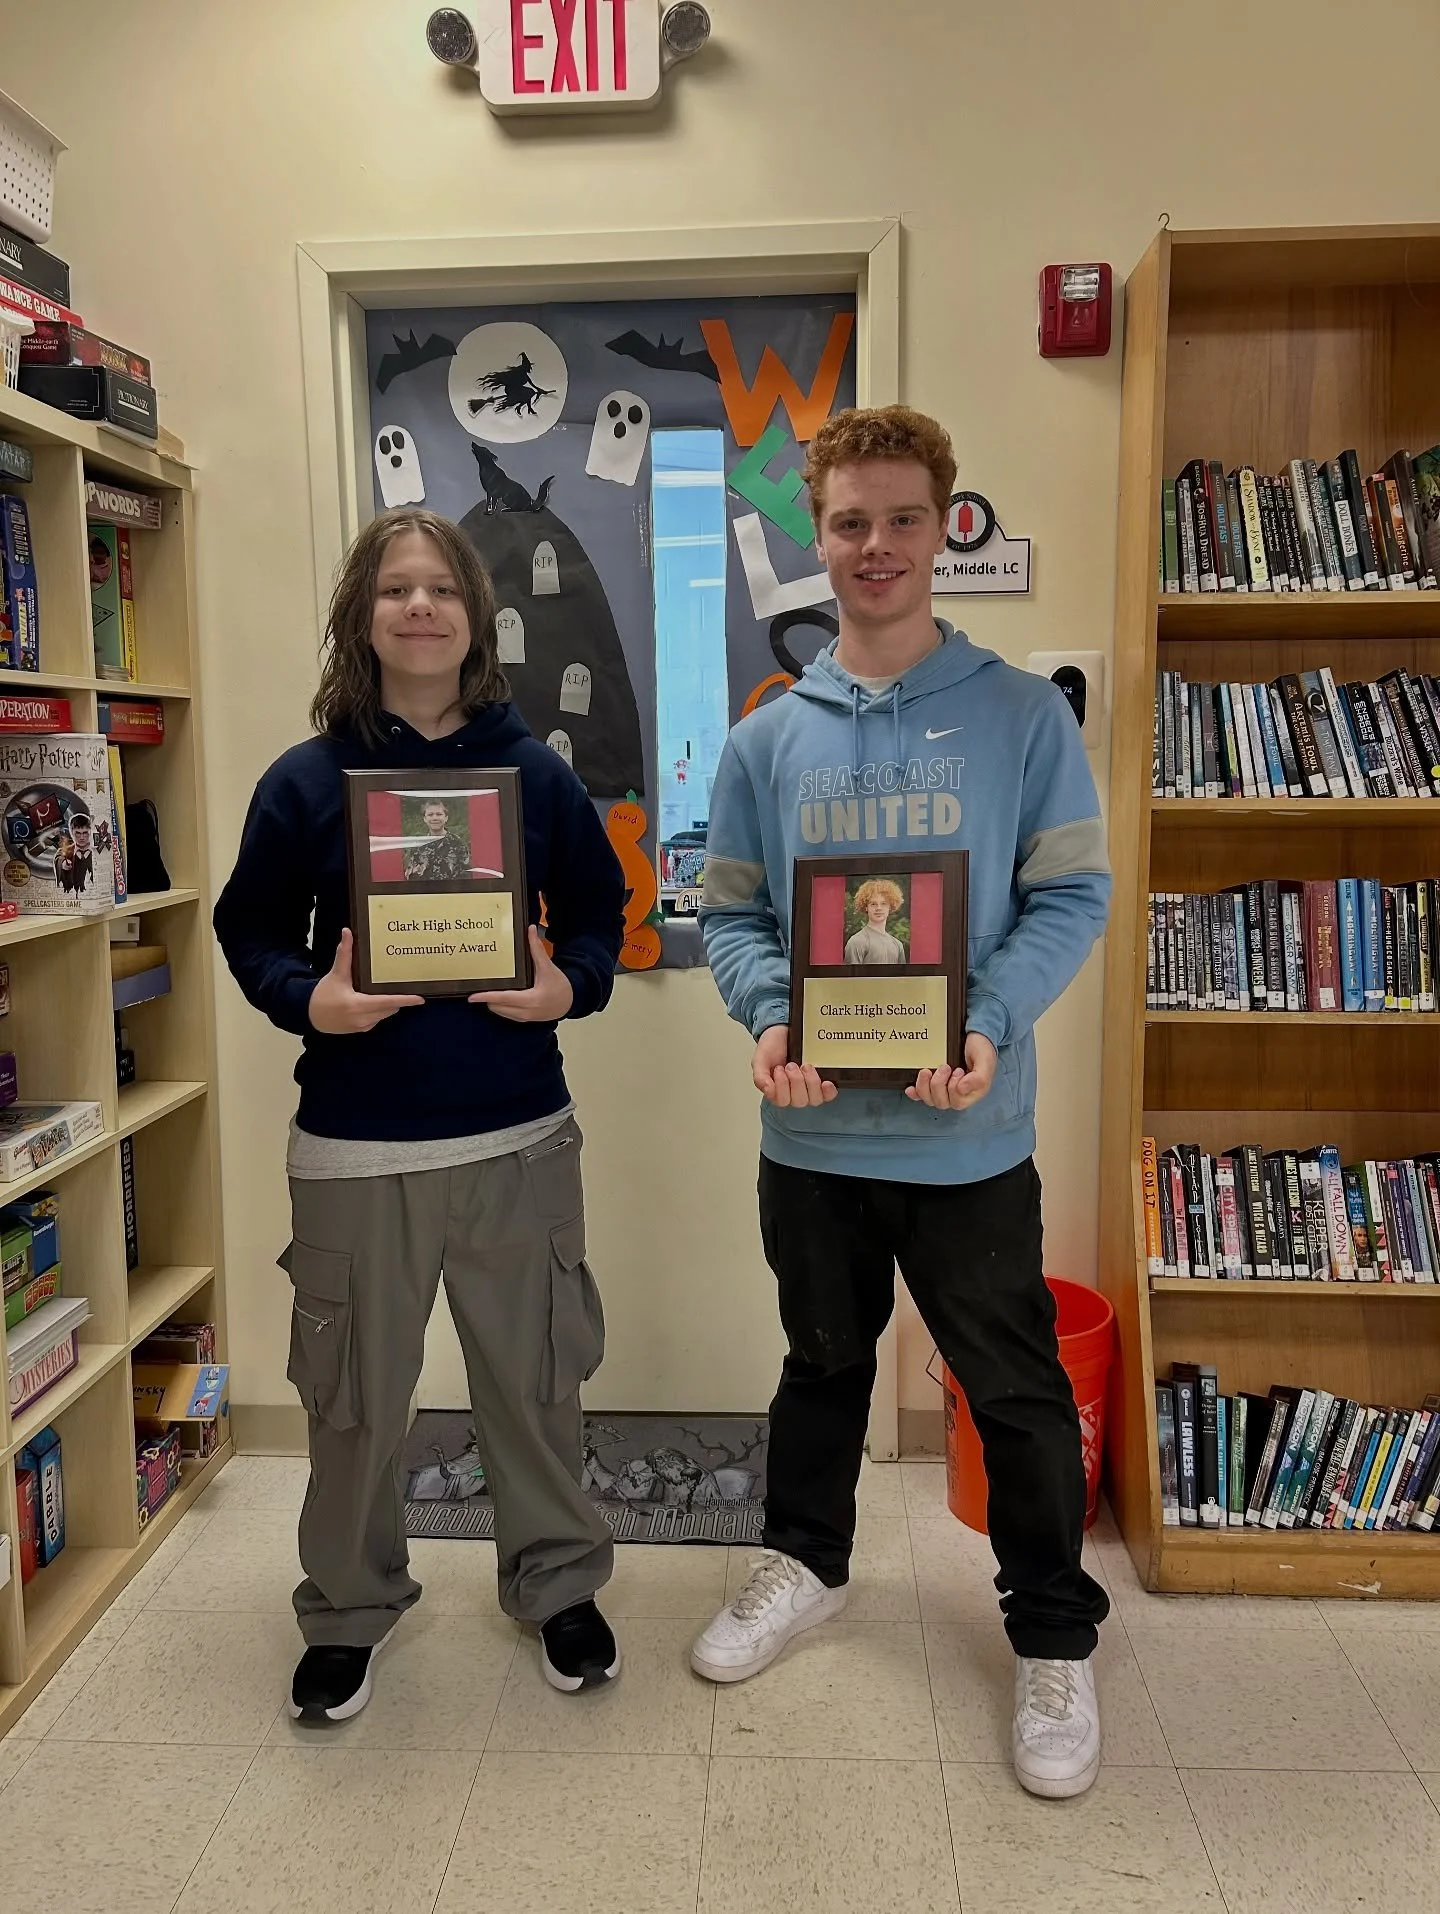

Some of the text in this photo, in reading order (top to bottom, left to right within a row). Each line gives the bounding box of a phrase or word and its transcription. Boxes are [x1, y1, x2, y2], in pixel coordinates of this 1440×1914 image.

[510, 0, 632, 94] EXIT
[34, 298, 61, 320] GAME
[1244, 488, 1258, 522] SHADOW
[1409, 477, 1420, 505] AMULET
[1195, 501, 1212, 569] JOSHUA DREAD
[1216, 503, 1228, 544] HOLD FAST
[1232, 521, 1243, 558] HOLD FAST
[1338, 503, 1355, 553] DOLL BONES
[534, 556, 553, 569] RIP
[1395, 524, 1412, 566] Tangerine
[953, 563, 997, 575] Middle
[1003, 562, 1019, 575] LC
[497, 618, 516, 630] RIP
[565, 673, 589, 687] RIP
[0, 701, 50, 721] PERATION
[1271, 746, 1280, 766] FOWL
[1294, 701, 1320, 771] ARTEMIS FOWL
[1419, 725, 1433, 752] VISSER
[0, 743, 82, 777] Harry Potter
[799, 757, 965, 800] SEACOAST
[1383, 735, 1406, 786] Blizzard's Wake
[800, 792, 962, 844] UNITED
[24, 900, 83, 909] SPELLCASTERS GAME
[683, 894, 700, 908] ALL
[387, 918, 494, 932] Clark High School
[1269, 908, 1278, 950] BLACK BOOK
[1347, 916, 1355, 972] MOCKINGJAY
[1371, 916, 1379, 972] MOCKINGJAY
[386, 941, 497, 955] Community Award
[1285, 924, 1295, 988] GAMER ARMY
[820, 1004, 926, 1018] Clark High School
[817, 1029, 928, 1042] Community Award
[1142, 1140, 1153, 1166] DOG
[1248, 1149, 1260, 1192] JAMES PATTERSON
[123, 1141, 135, 1240] HORRIFIED
[1144, 1171, 1155, 1187] ON
[1284, 1155, 1301, 1208] JAMES PATTERSON
[1331, 1187, 1345, 1212] FALL
[1145, 1192, 1156, 1208] IT
[1222, 1186, 1238, 1246] CITY SPIES
[1252, 1202, 1264, 1221] WITCH
[1255, 1229, 1267, 1254] WIZARD
[1304, 1200, 1319, 1254] LOST CITIES
[1312, 1199, 1329, 1251] KEEPER
[1332, 1214, 1350, 1255] DOWN
[22, 1339, 72, 1397] MYSTERIES
[1288, 1396, 1311, 1451] HORIZON
[1306, 1398, 1330, 1453] HORIZON
[1182, 1421, 1194, 1477] LAWLESS
[1320, 1436, 1347, 1498] MORTAL ENGINES
[1303, 1450, 1326, 1506] BAR CODE PROPHECY
[45, 1466, 57, 1544] DABBLE
[650, 1507, 766, 1538] Mortals
